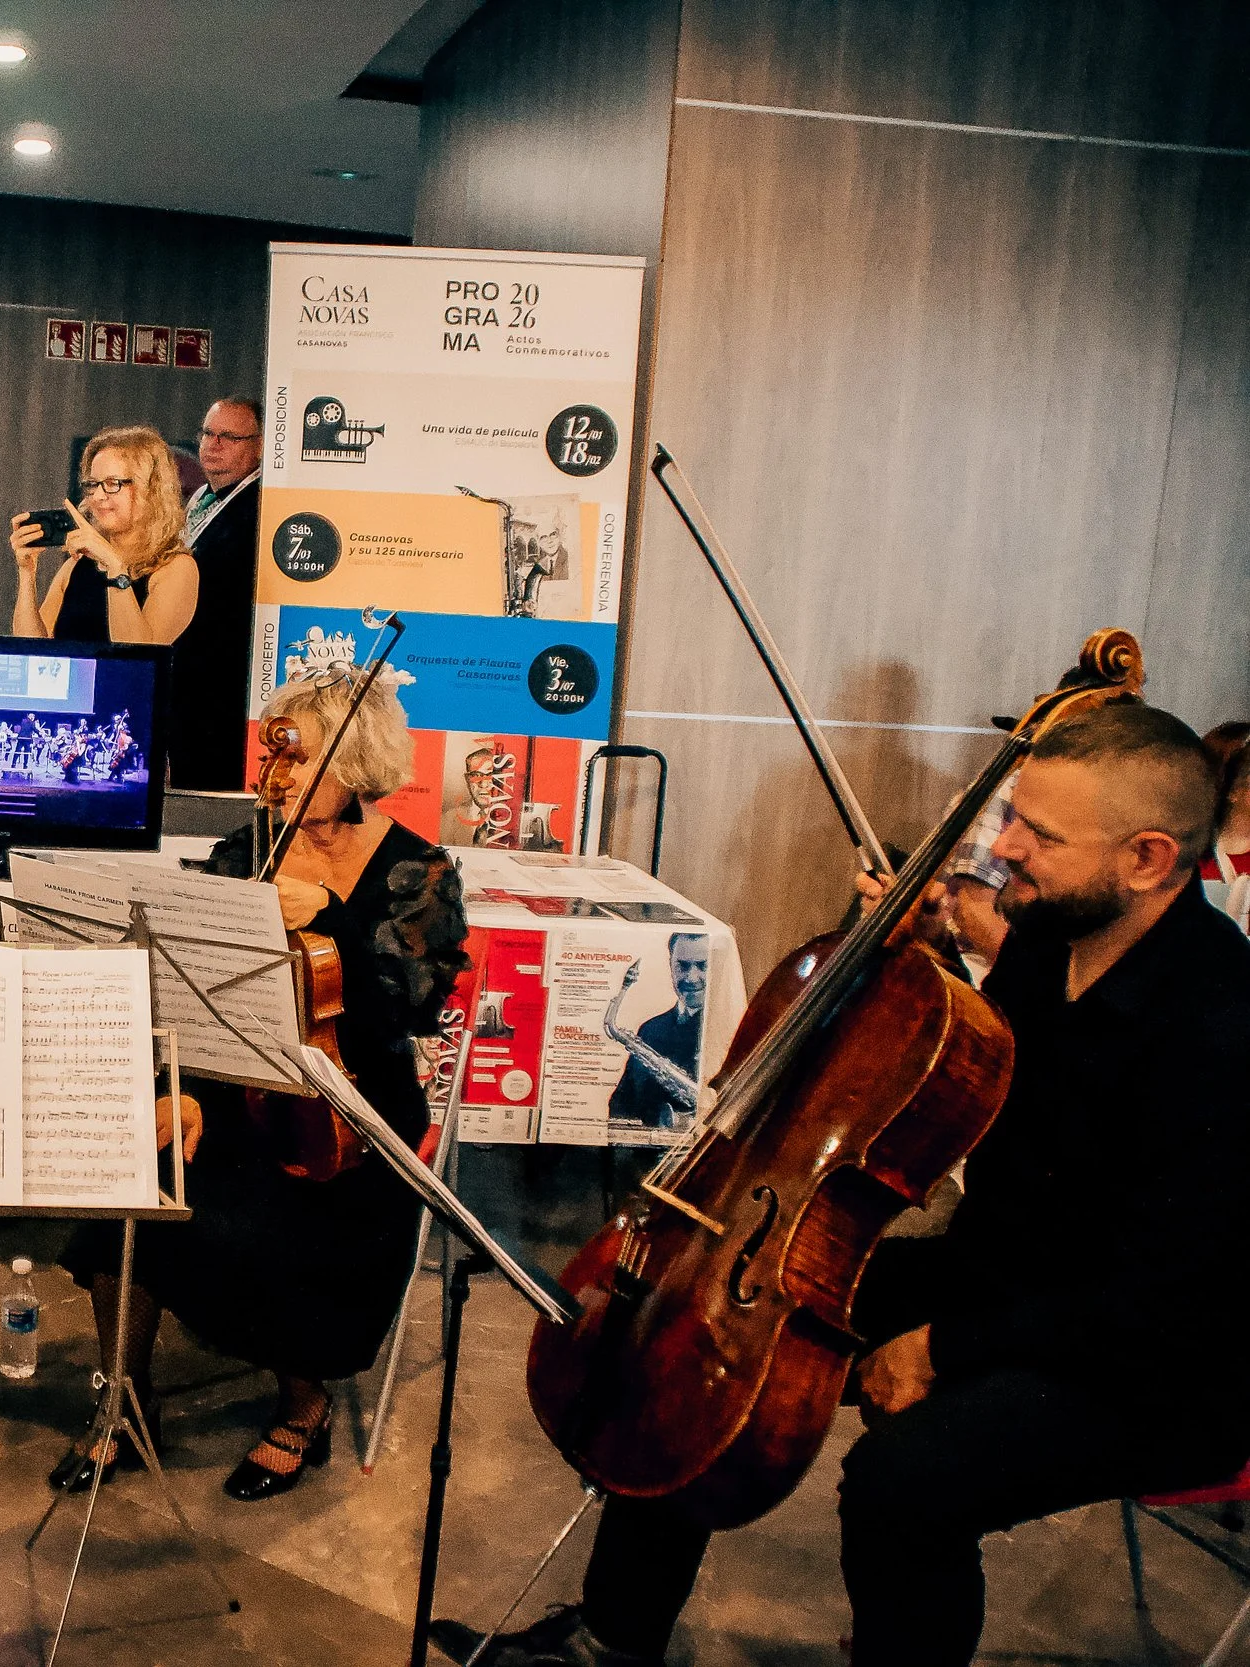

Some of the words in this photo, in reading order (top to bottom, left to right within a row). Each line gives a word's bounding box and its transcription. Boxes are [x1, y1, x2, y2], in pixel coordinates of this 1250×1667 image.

[301, 275, 369, 303] CASA
[446, 280, 500, 301] PRO
[509, 282, 540, 306] 20
[299, 305, 369, 325] NOVAS
[444, 306, 500, 327] GRA
[508, 306, 537, 329] 26
[297, 340, 348, 348] CASANOVAS
[442, 332, 481, 352] MA
[507, 334, 542, 345] Actos
[506, 345, 611, 358] Conmemorativos
[274, 386, 288, 469] EXPOSICIÓN
[422, 424, 445, 434] Una
[448, 424, 472, 435] vida
[475, 425, 490, 436] de
[349, 532, 414, 544] Casanovas
[348, 547, 356, 556] y
[358, 547, 373, 556] su
[375, 547, 396, 556] 125
[398, 549, 464, 560] aniversario
[598, 513, 615, 612] CONFERENCIA
[260, 623, 275, 702] CONCIERTO
[406, 654, 459, 666] Orquesta
[462, 656, 476, 667] de
[479, 657, 522, 669] Flautas
[457, 670, 522, 682] Casanovas
[546, 693, 585, 703] 20:00H
[486, 753, 517, 848] NOVAS
[78, 891, 96, 900] FROM
[97, 895, 124, 907] CARMEN
[561, 952, 573, 960] 40
[575, 952, 633, 962] ANIVERSARIO
[553, 1032, 600, 1041] CONCERTS
[554, 1025, 584, 1034] FAMILY
